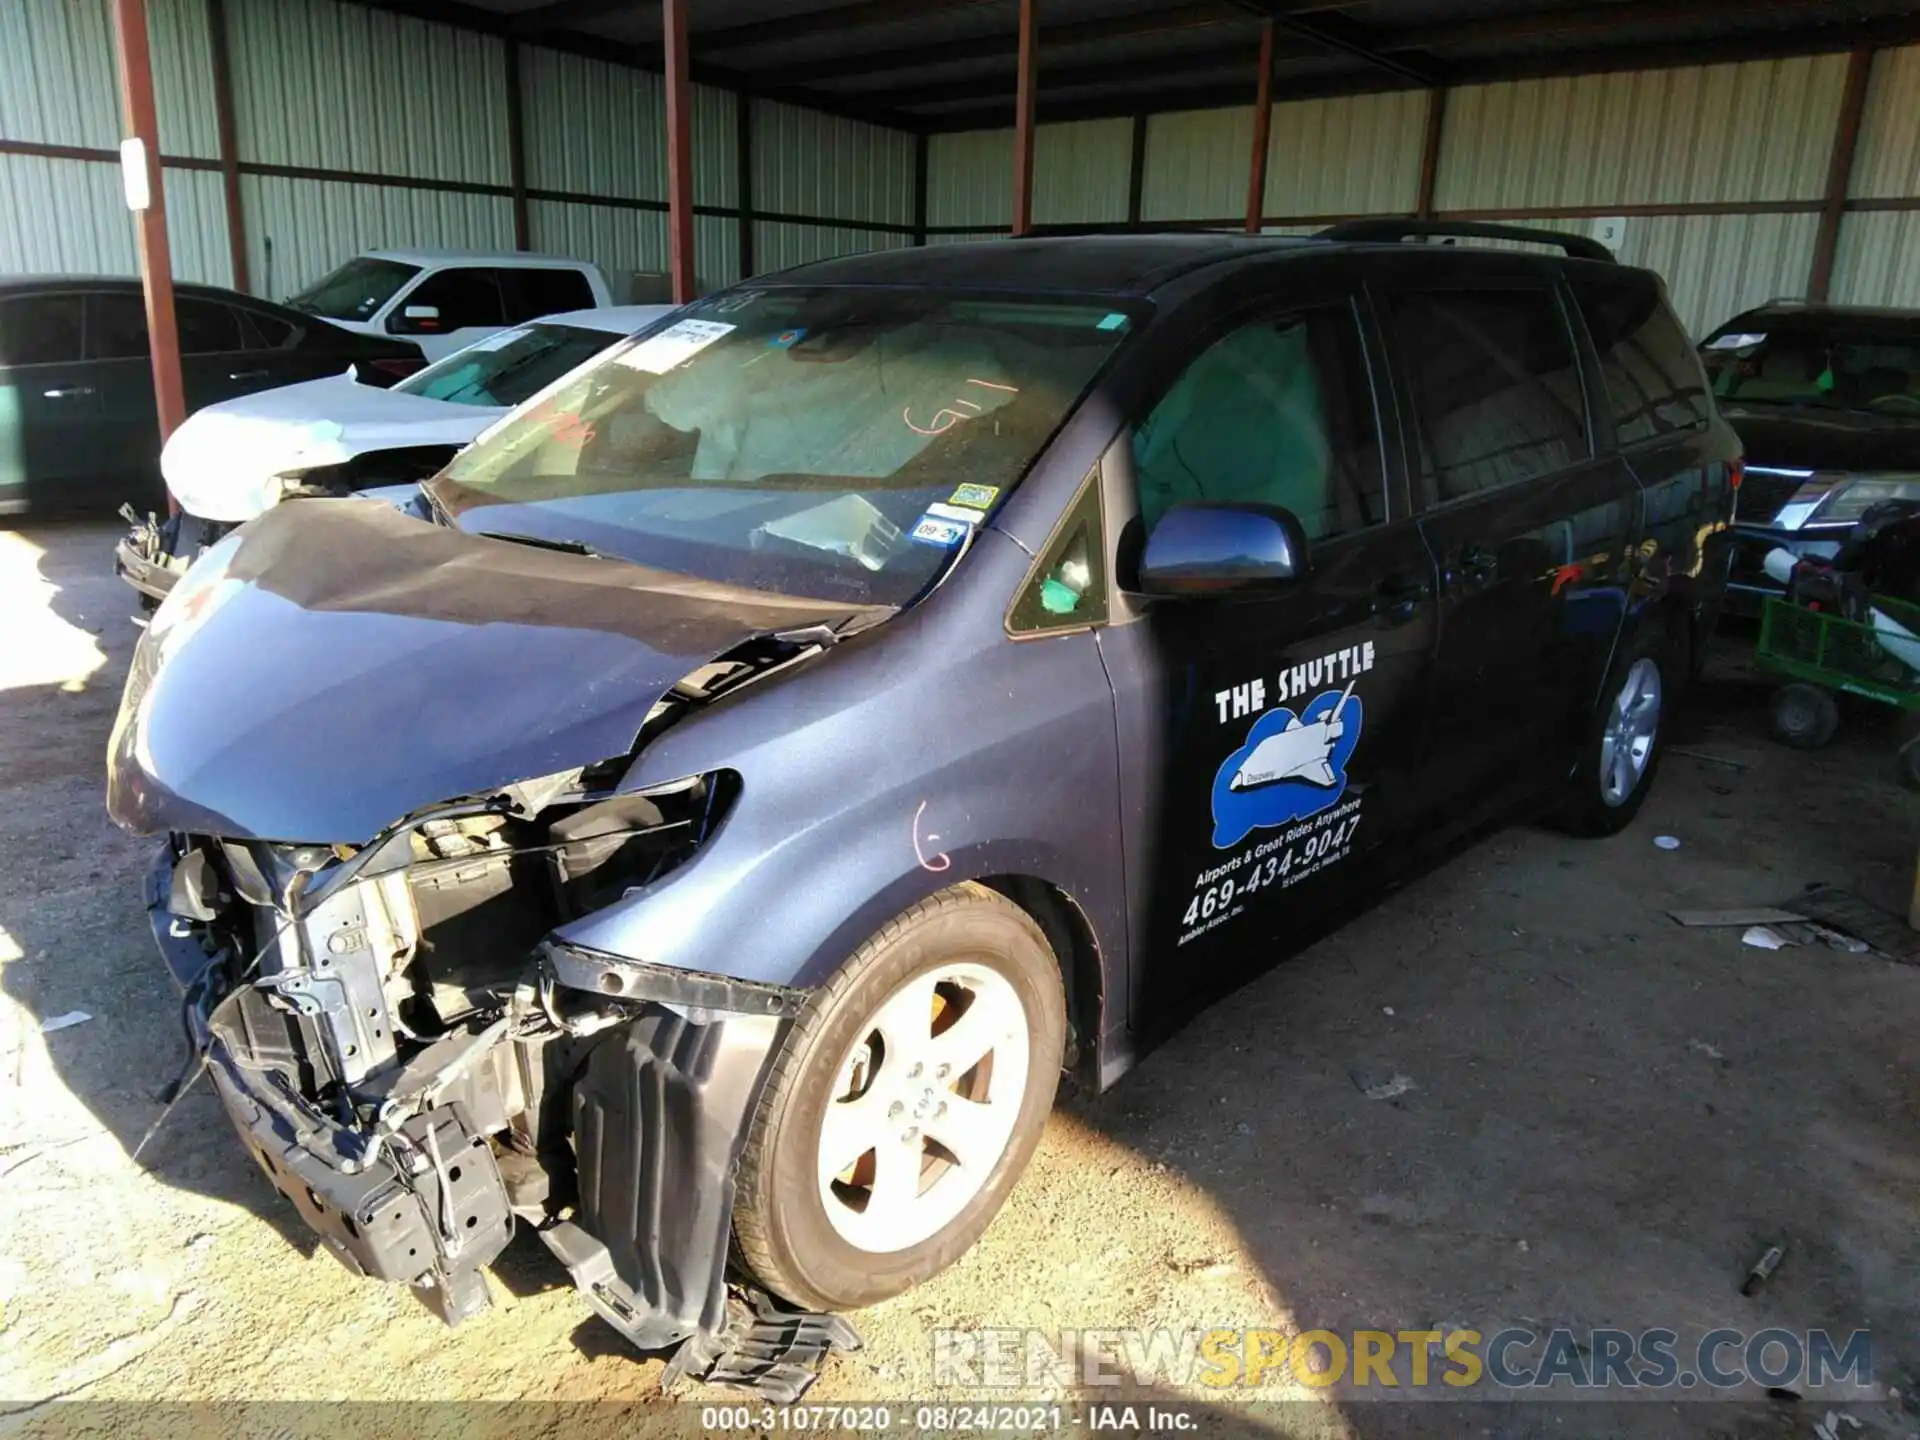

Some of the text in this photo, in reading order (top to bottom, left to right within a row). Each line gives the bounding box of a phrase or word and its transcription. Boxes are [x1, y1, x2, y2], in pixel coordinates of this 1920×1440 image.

[1215, 640, 1375, 724] THE SHUTTLE
[1182, 814, 1361, 926] 469-434-9047
[1195, 856, 1242, 889] Airports
[1254, 835, 1284, 858] Great
[1285, 823, 1313, 842] Rides
[1315, 798, 1362, 829] Anywhere
